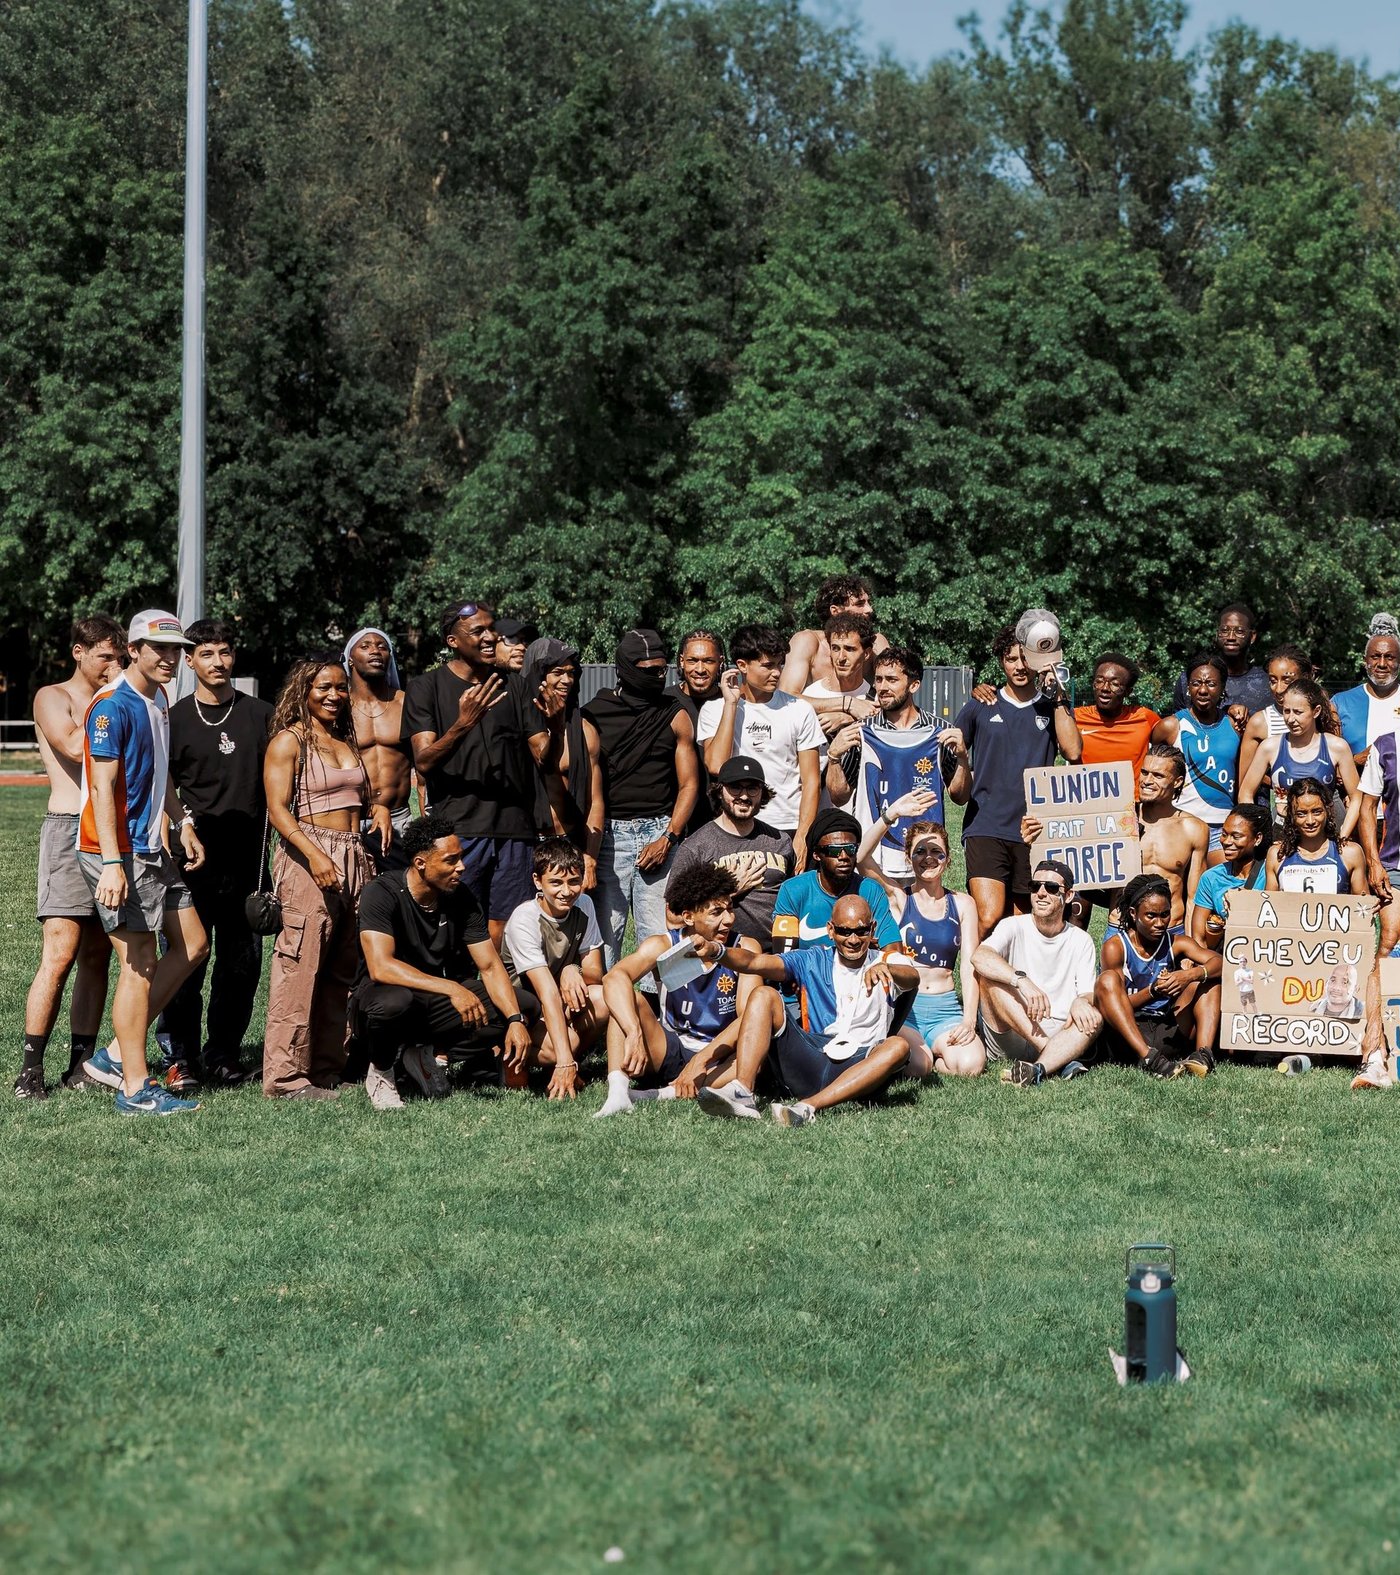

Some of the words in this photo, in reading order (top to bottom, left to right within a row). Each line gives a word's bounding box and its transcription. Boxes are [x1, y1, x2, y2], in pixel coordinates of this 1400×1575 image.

[1048, 820, 1085, 839] FAIT
[1096, 815, 1117, 834] LA
[1257, 892, 1278, 928] À
[1300, 902, 1351, 933] UN
[1225, 936, 1362, 967] CHEVEU
[1282, 976, 1324, 1005] DU
[1231, 1014, 1351, 1047] RECORD
